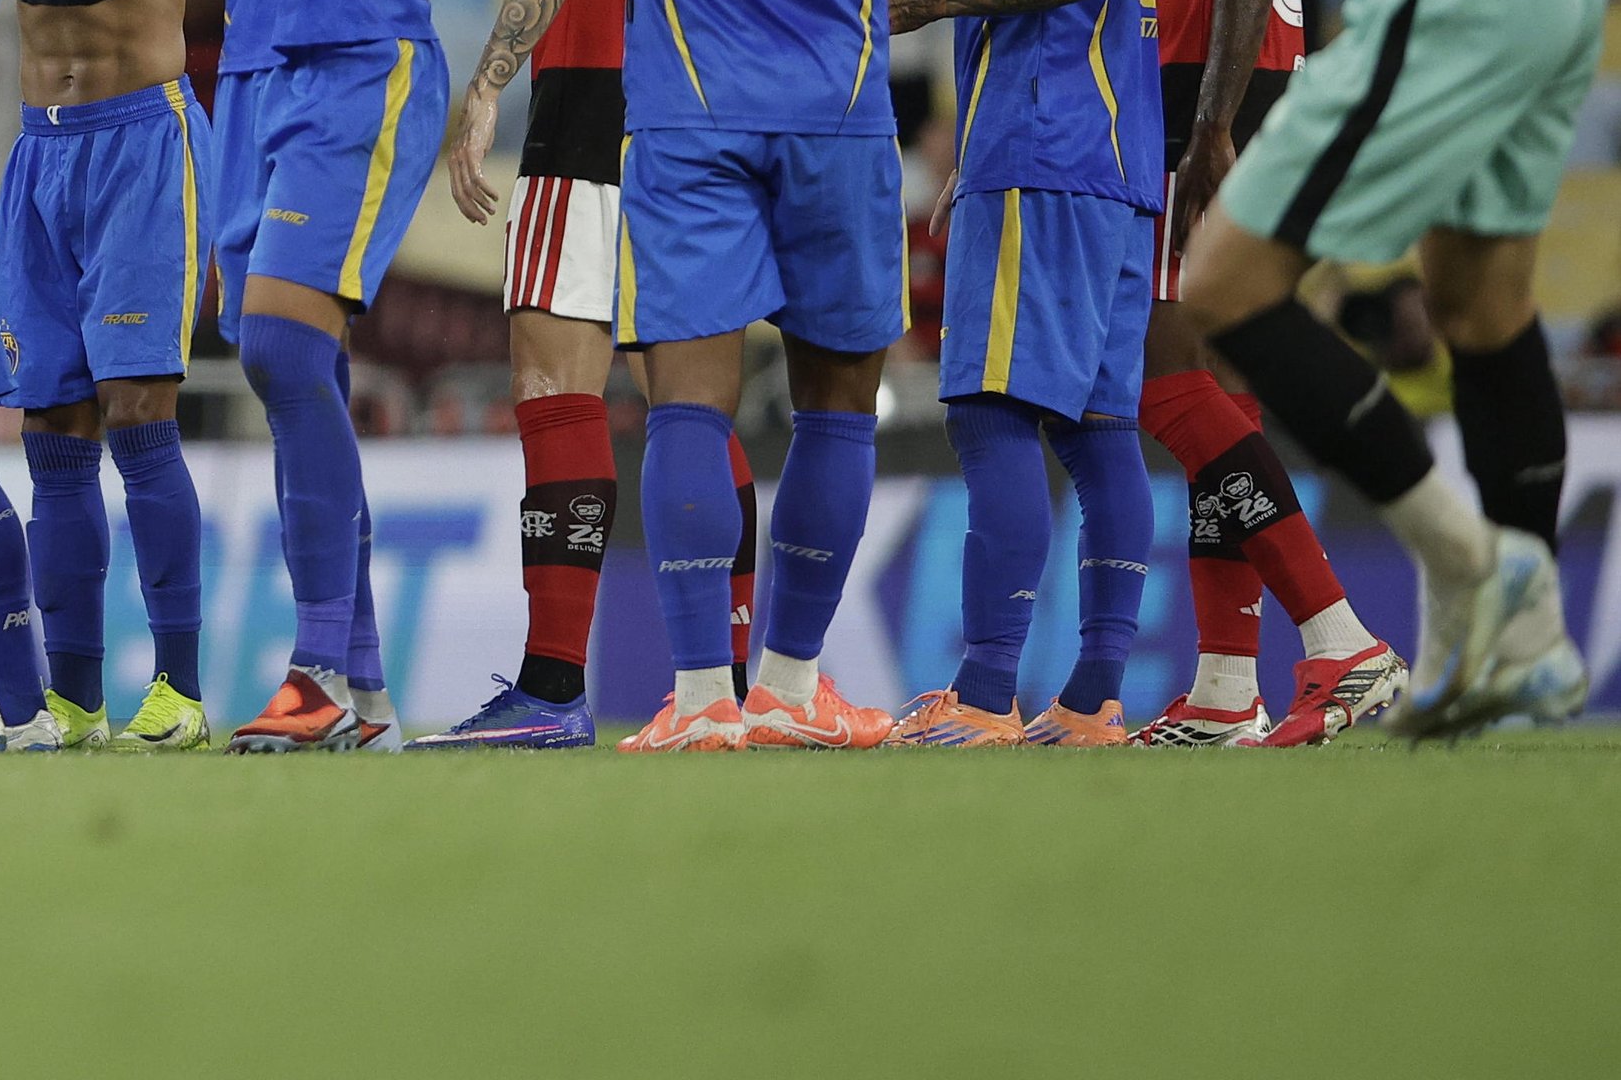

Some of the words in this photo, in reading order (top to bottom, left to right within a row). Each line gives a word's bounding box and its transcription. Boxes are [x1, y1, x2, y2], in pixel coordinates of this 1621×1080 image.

[101, 312, 149, 325] PRATIC
[1232, 490, 1275, 523] Zé
[1243, 506, 1279, 530] DELIVERY
[566, 523, 605, 547] Zé
